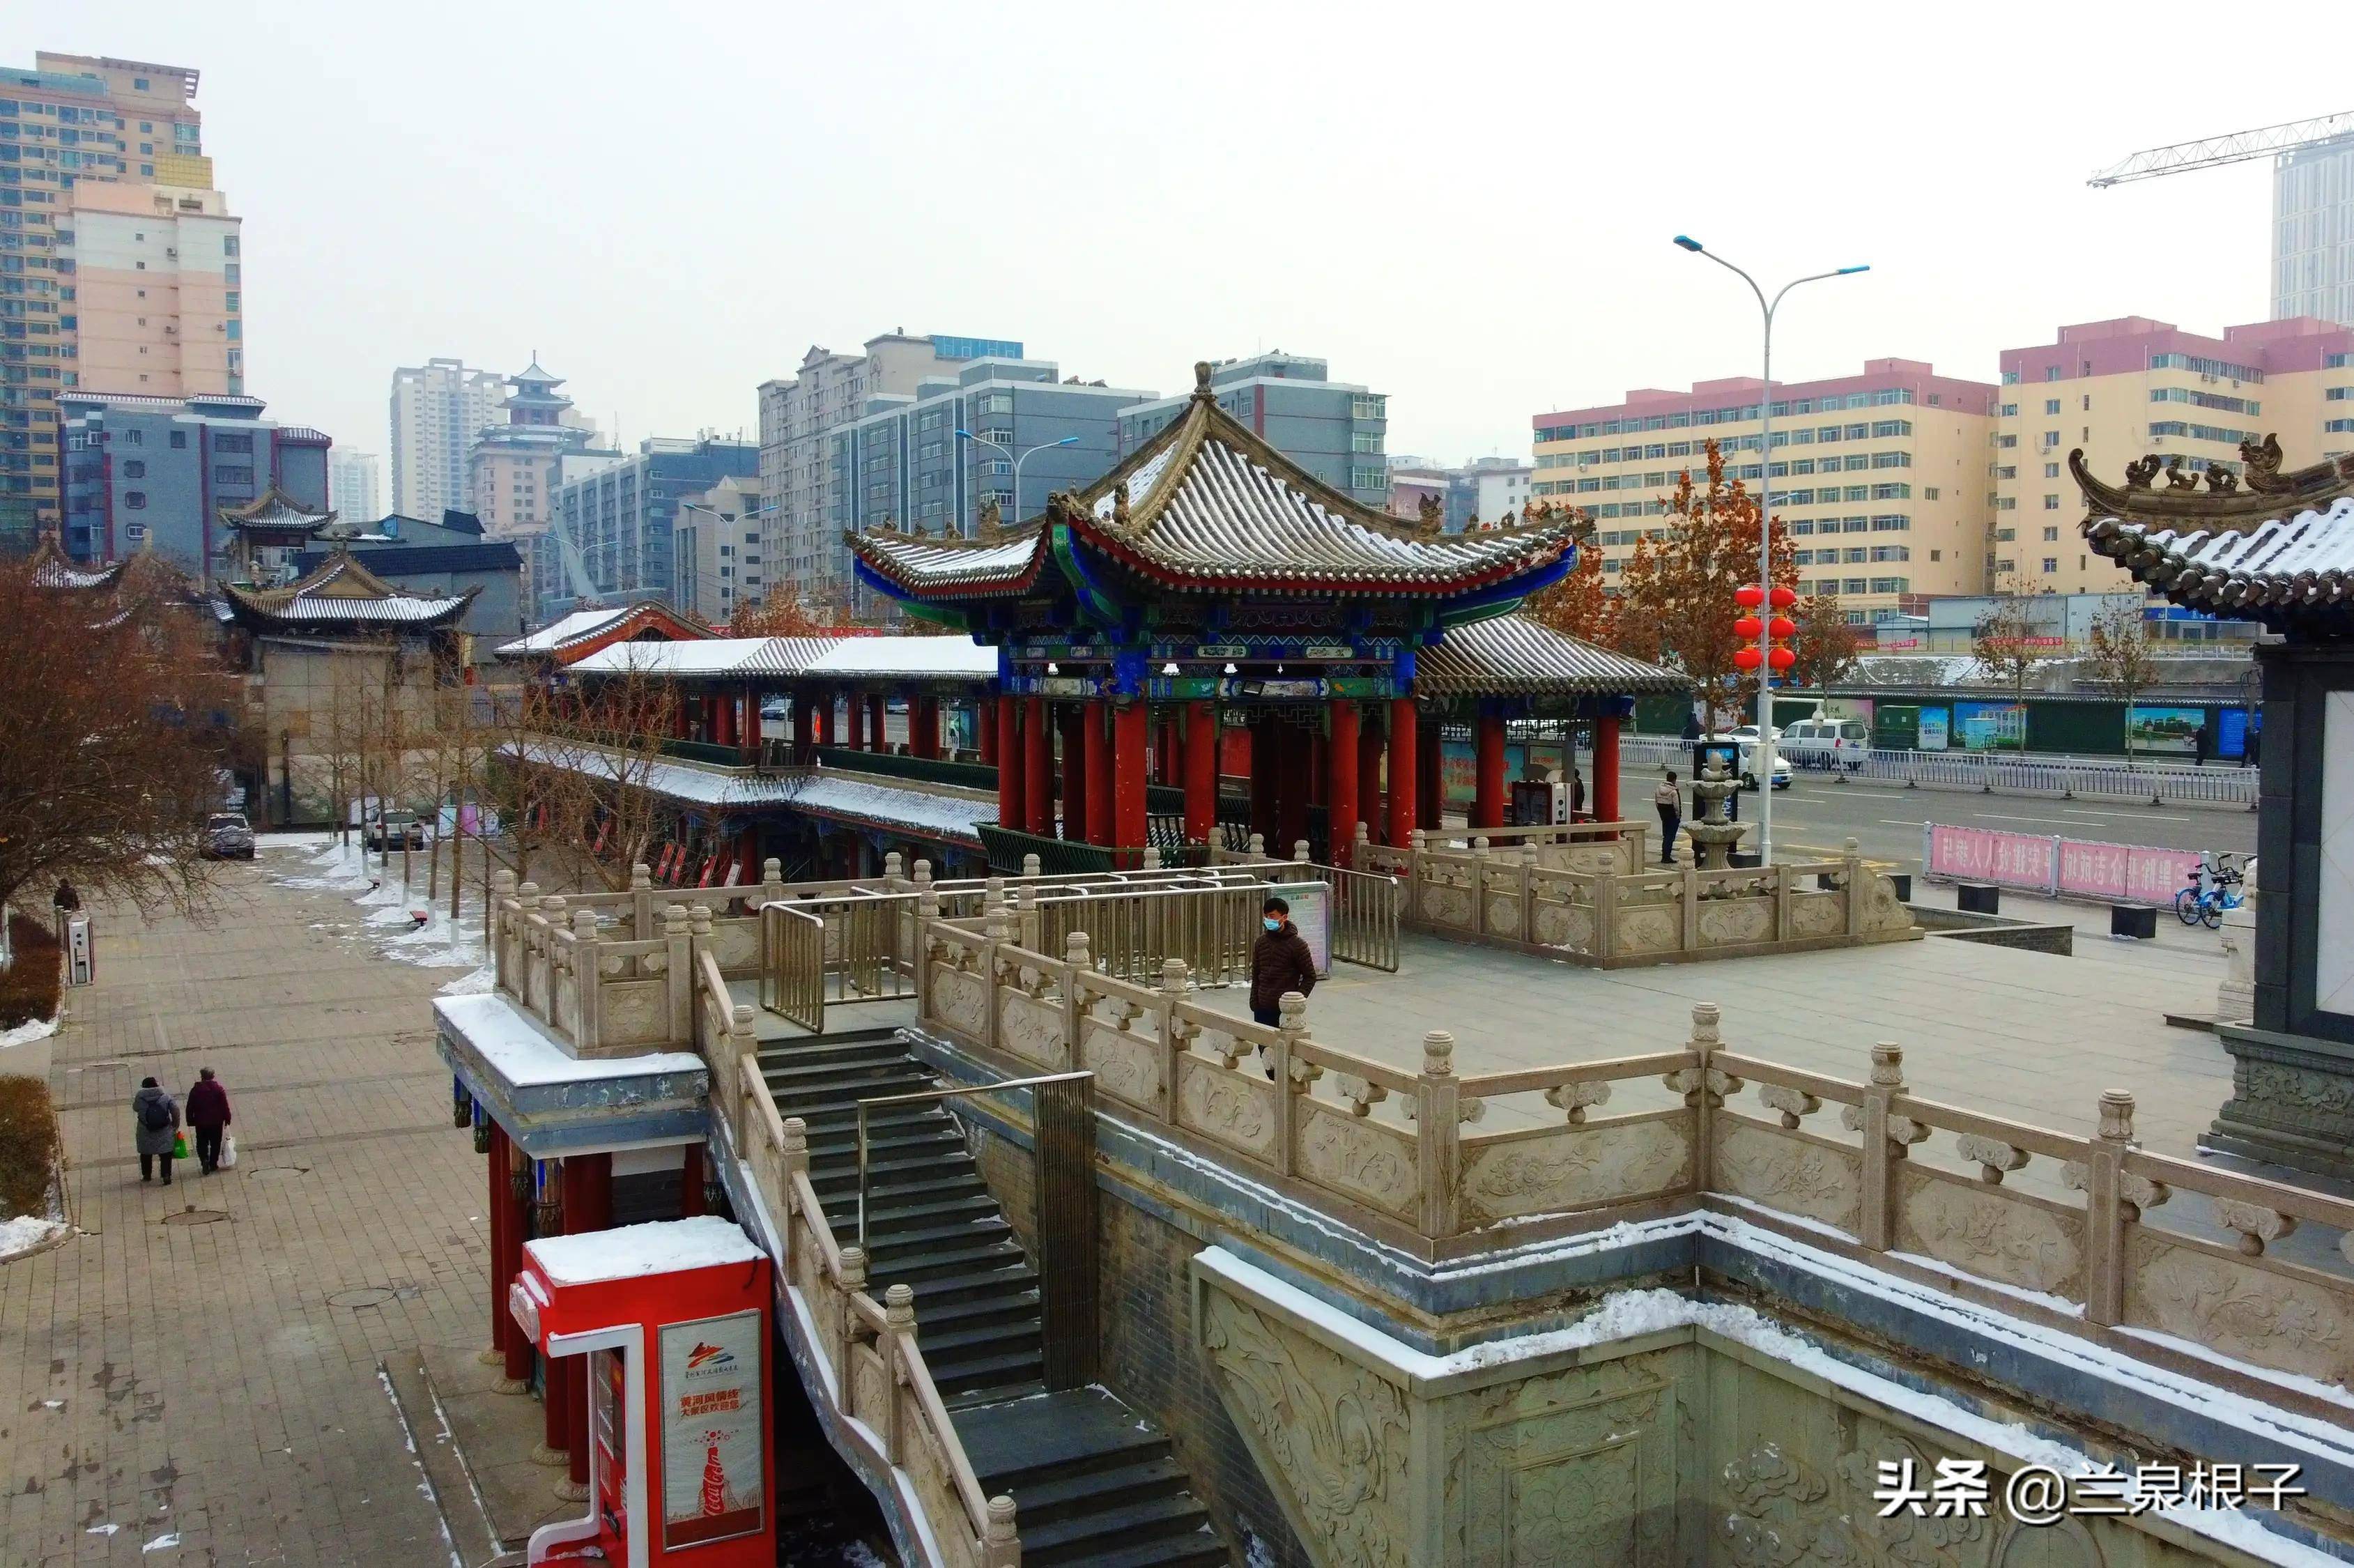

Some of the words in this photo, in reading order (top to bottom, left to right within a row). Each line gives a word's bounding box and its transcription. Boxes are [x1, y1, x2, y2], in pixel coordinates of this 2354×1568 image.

[681, 1388, 739, 1408] 黄河风情线
[680, 1399, 739, 1417] 大景区欢迎您
